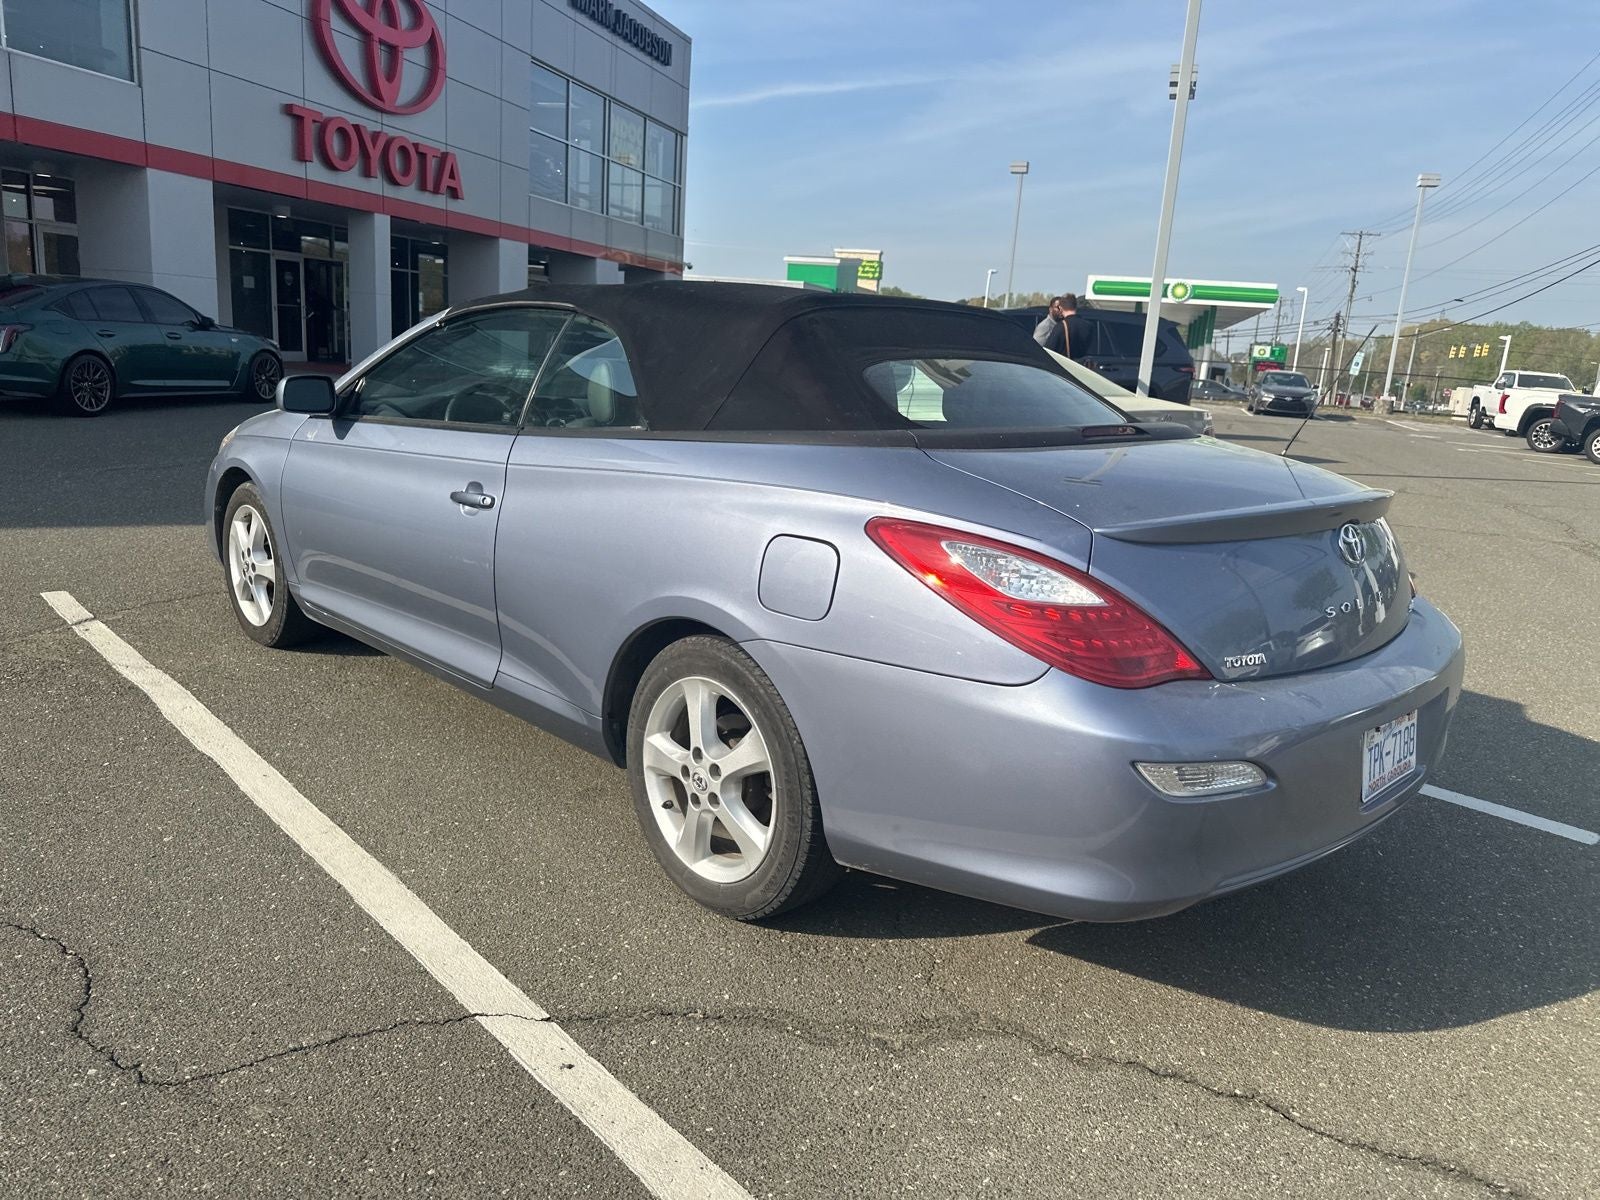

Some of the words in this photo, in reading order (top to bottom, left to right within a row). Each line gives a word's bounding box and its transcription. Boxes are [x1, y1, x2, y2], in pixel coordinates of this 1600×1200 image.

[614, 9, 673, 66] JACOBSON
[284, 103, 465, 200] TOYOTA
[1224, 652, 1267, 668] TOYOTA
[1368, 723, 1415, 782] TPK-7188
